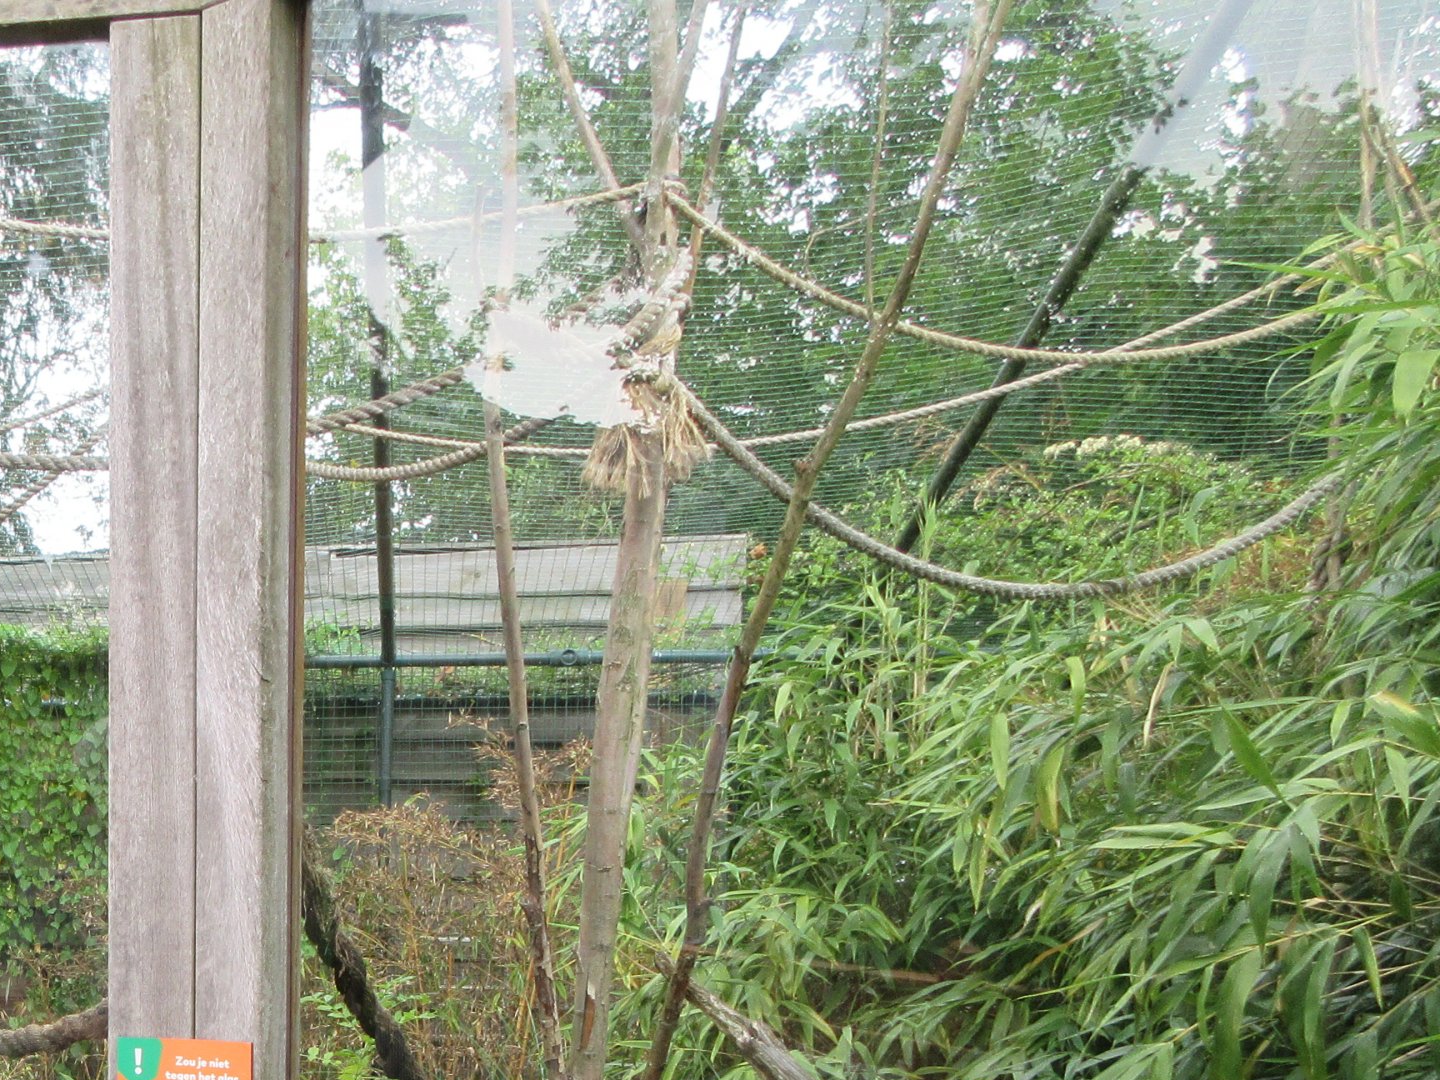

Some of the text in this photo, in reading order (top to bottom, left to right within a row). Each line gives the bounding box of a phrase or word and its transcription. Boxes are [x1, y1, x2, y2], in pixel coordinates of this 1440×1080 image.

[175, 1055, 230, 1069] Zou je niet
